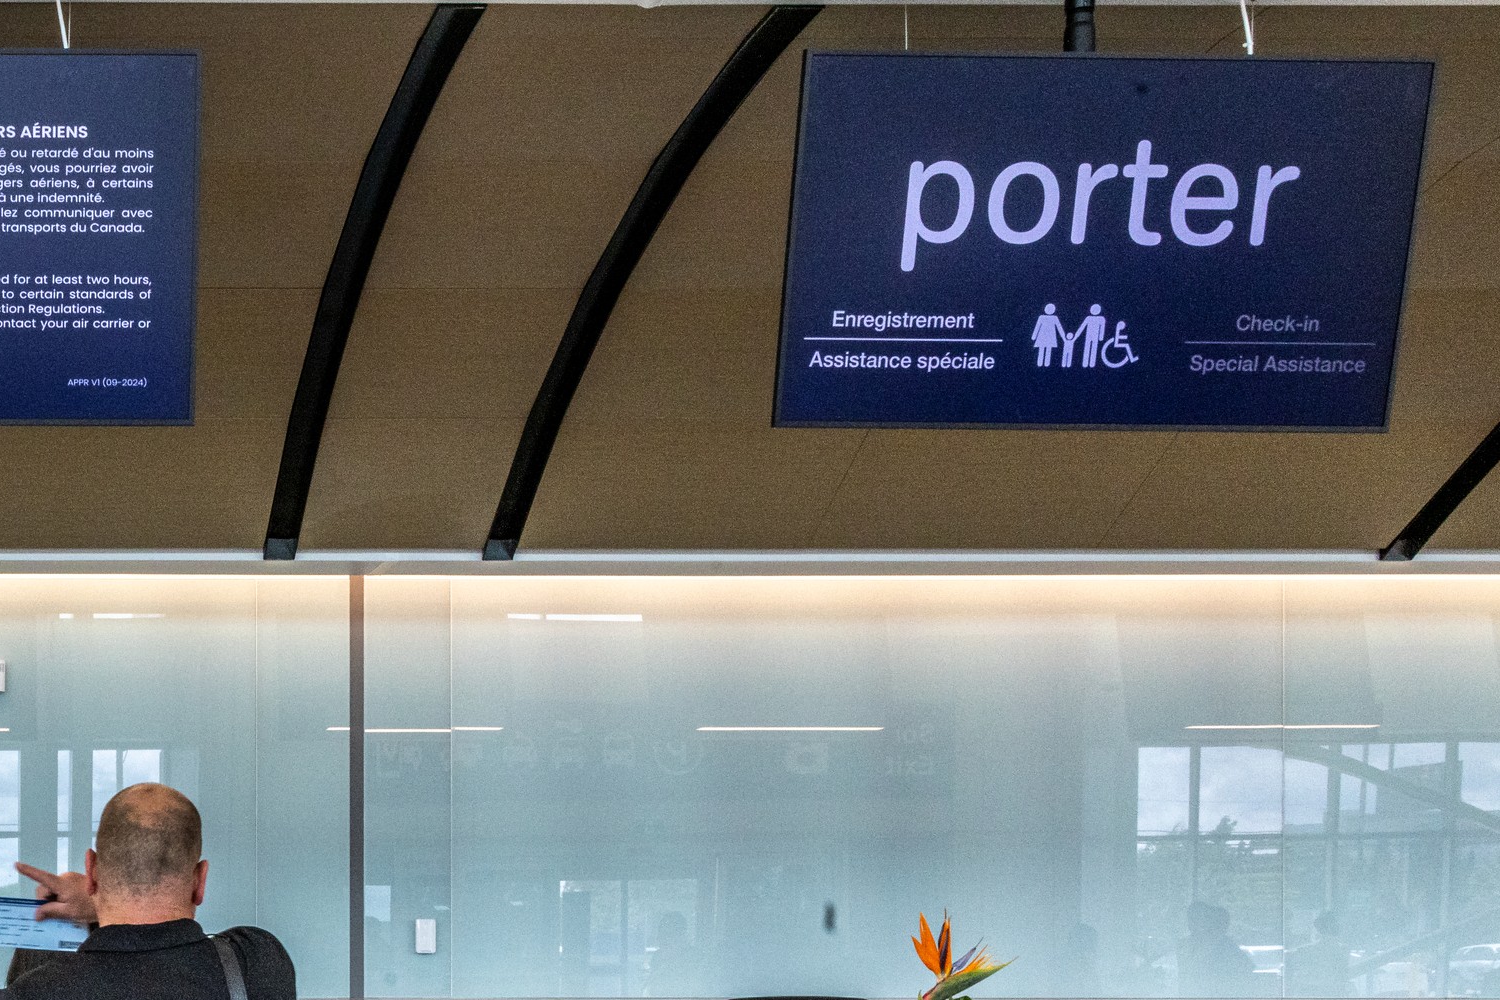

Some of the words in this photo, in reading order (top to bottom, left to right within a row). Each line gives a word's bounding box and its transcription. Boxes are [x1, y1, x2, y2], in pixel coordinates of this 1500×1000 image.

[21, 122, 88, 138] AÉRIENS
[10, 149, 27, 158] ou
[32, 148, 79, 158] retardé
[83, 147, 110, 158] d'au
[115, 147, 154, 158] moins
[30, 164, 60, 173] vous
[65, 163, 116, 176] pourriez
[122, 163, 154, 173] avoir
[30, 177, 79, 189] aériens,
[86, 177, 95, 188] à
[102, 178, 153, 188] certains
[900, 140, 1300, 272] porter
[24, 207, 115, 221] communiquer
[121, 210, 153, 218] avec
[1, 222, 66, 235] transports
[70, 222, 87, 233] du
[90, 222, 145, 233] Canada.
[13, 274, 31, 285] for
[34, 275, 48, 284] at
[52, 274, 82, 284] least
[86, 275, 110, 285] two
[114, 274, 152, 286] hours,
[2, 289, 14, 299] to
[19, 289, 64, 299] certain
[69, 289, 134, 299] standards
[139, 289, 152, 300] of
[40, 320, 68, 331] your
[72, 318, 89, 329] air
[93, 318, 134, 329] carrier
[138, 320, 151, 328] or
[832, 310, 975, 332] Enregistrement
[1236, 314, 1320, 332] Check-in
[809, 350, 912, 369] Assistance
[916, 351, 995, 373] spéciale
[1190, 354, 1260, 375] Special
[1263, 355, 1366, 373] Assistance
[67, 378, 89, 386] APPR
[102, 377, 147, 388] (09-2024)
